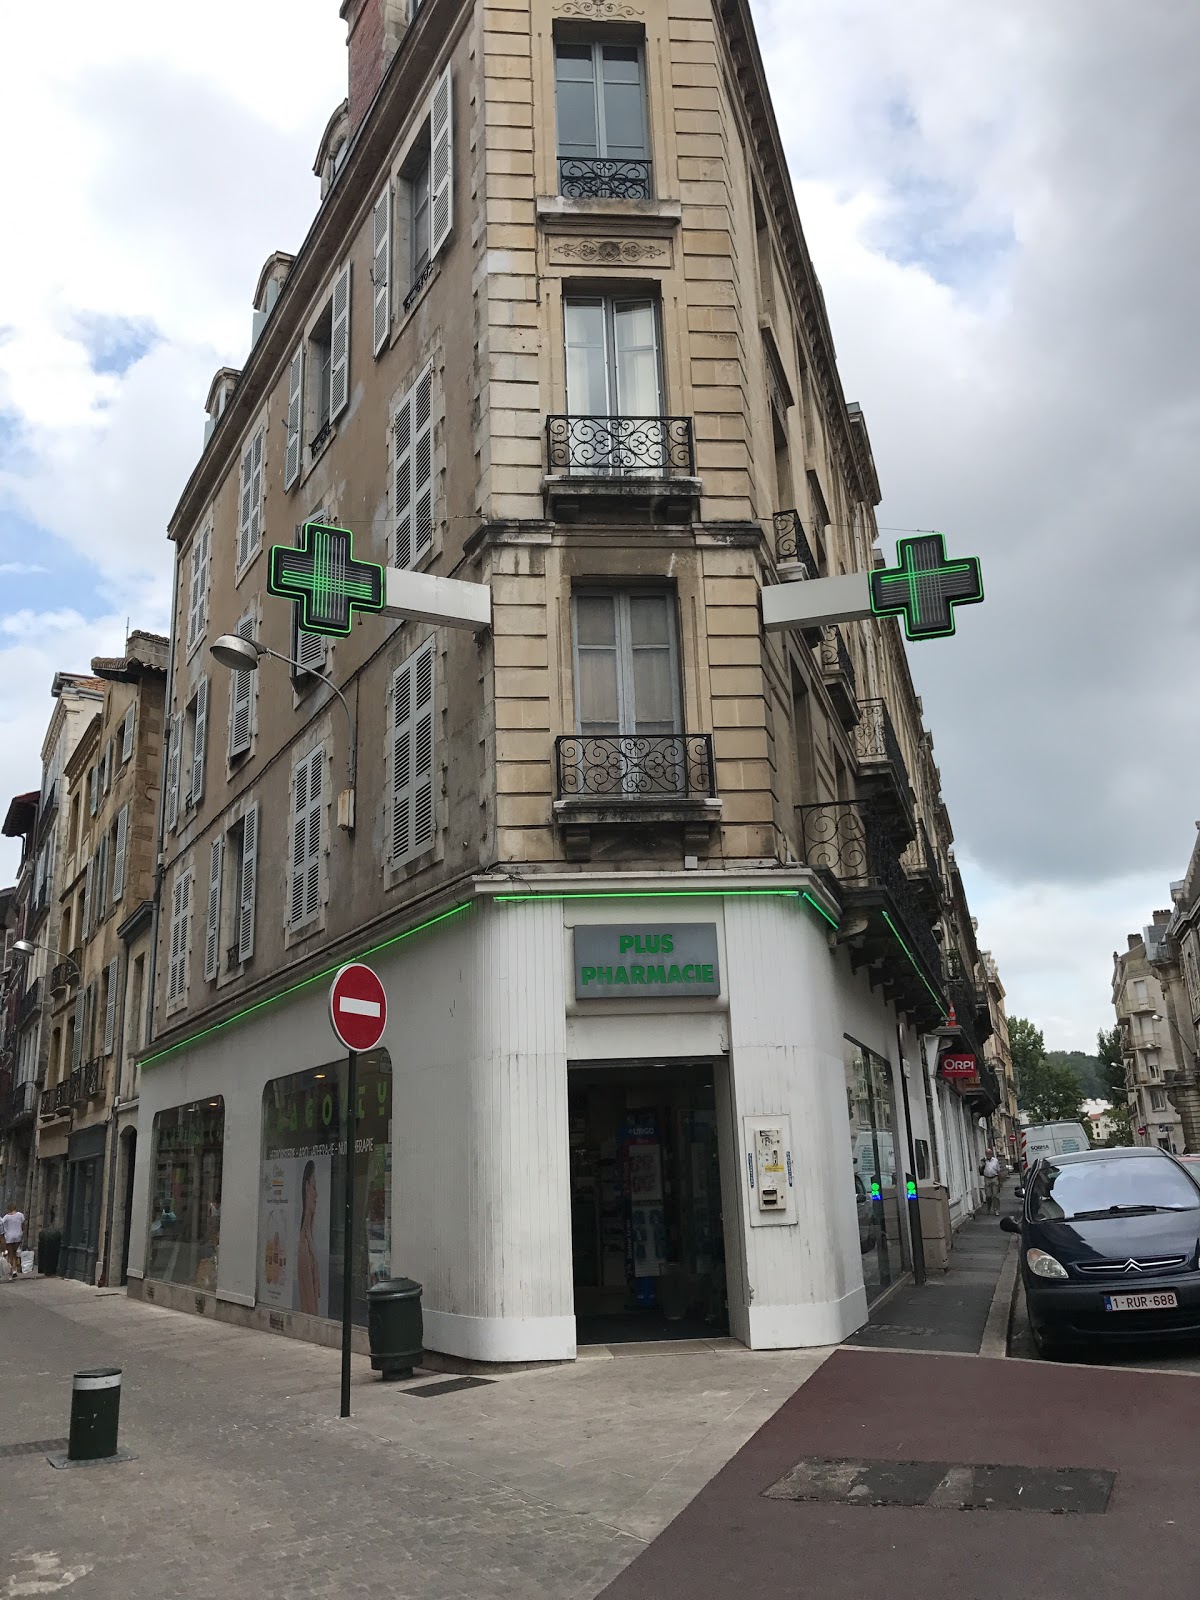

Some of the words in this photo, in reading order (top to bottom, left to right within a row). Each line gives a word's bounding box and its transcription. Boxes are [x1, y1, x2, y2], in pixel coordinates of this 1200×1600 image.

[619, 933, 674, 954] PLUS
[581, 963, 715, 986] PHARMACIE
[944, 1059, 974, 1070] ORPI
[338, 1137, 374, 1155] NUTHERAPIE
[1112, 1294, 1175, 1309] 1-RUR-688
